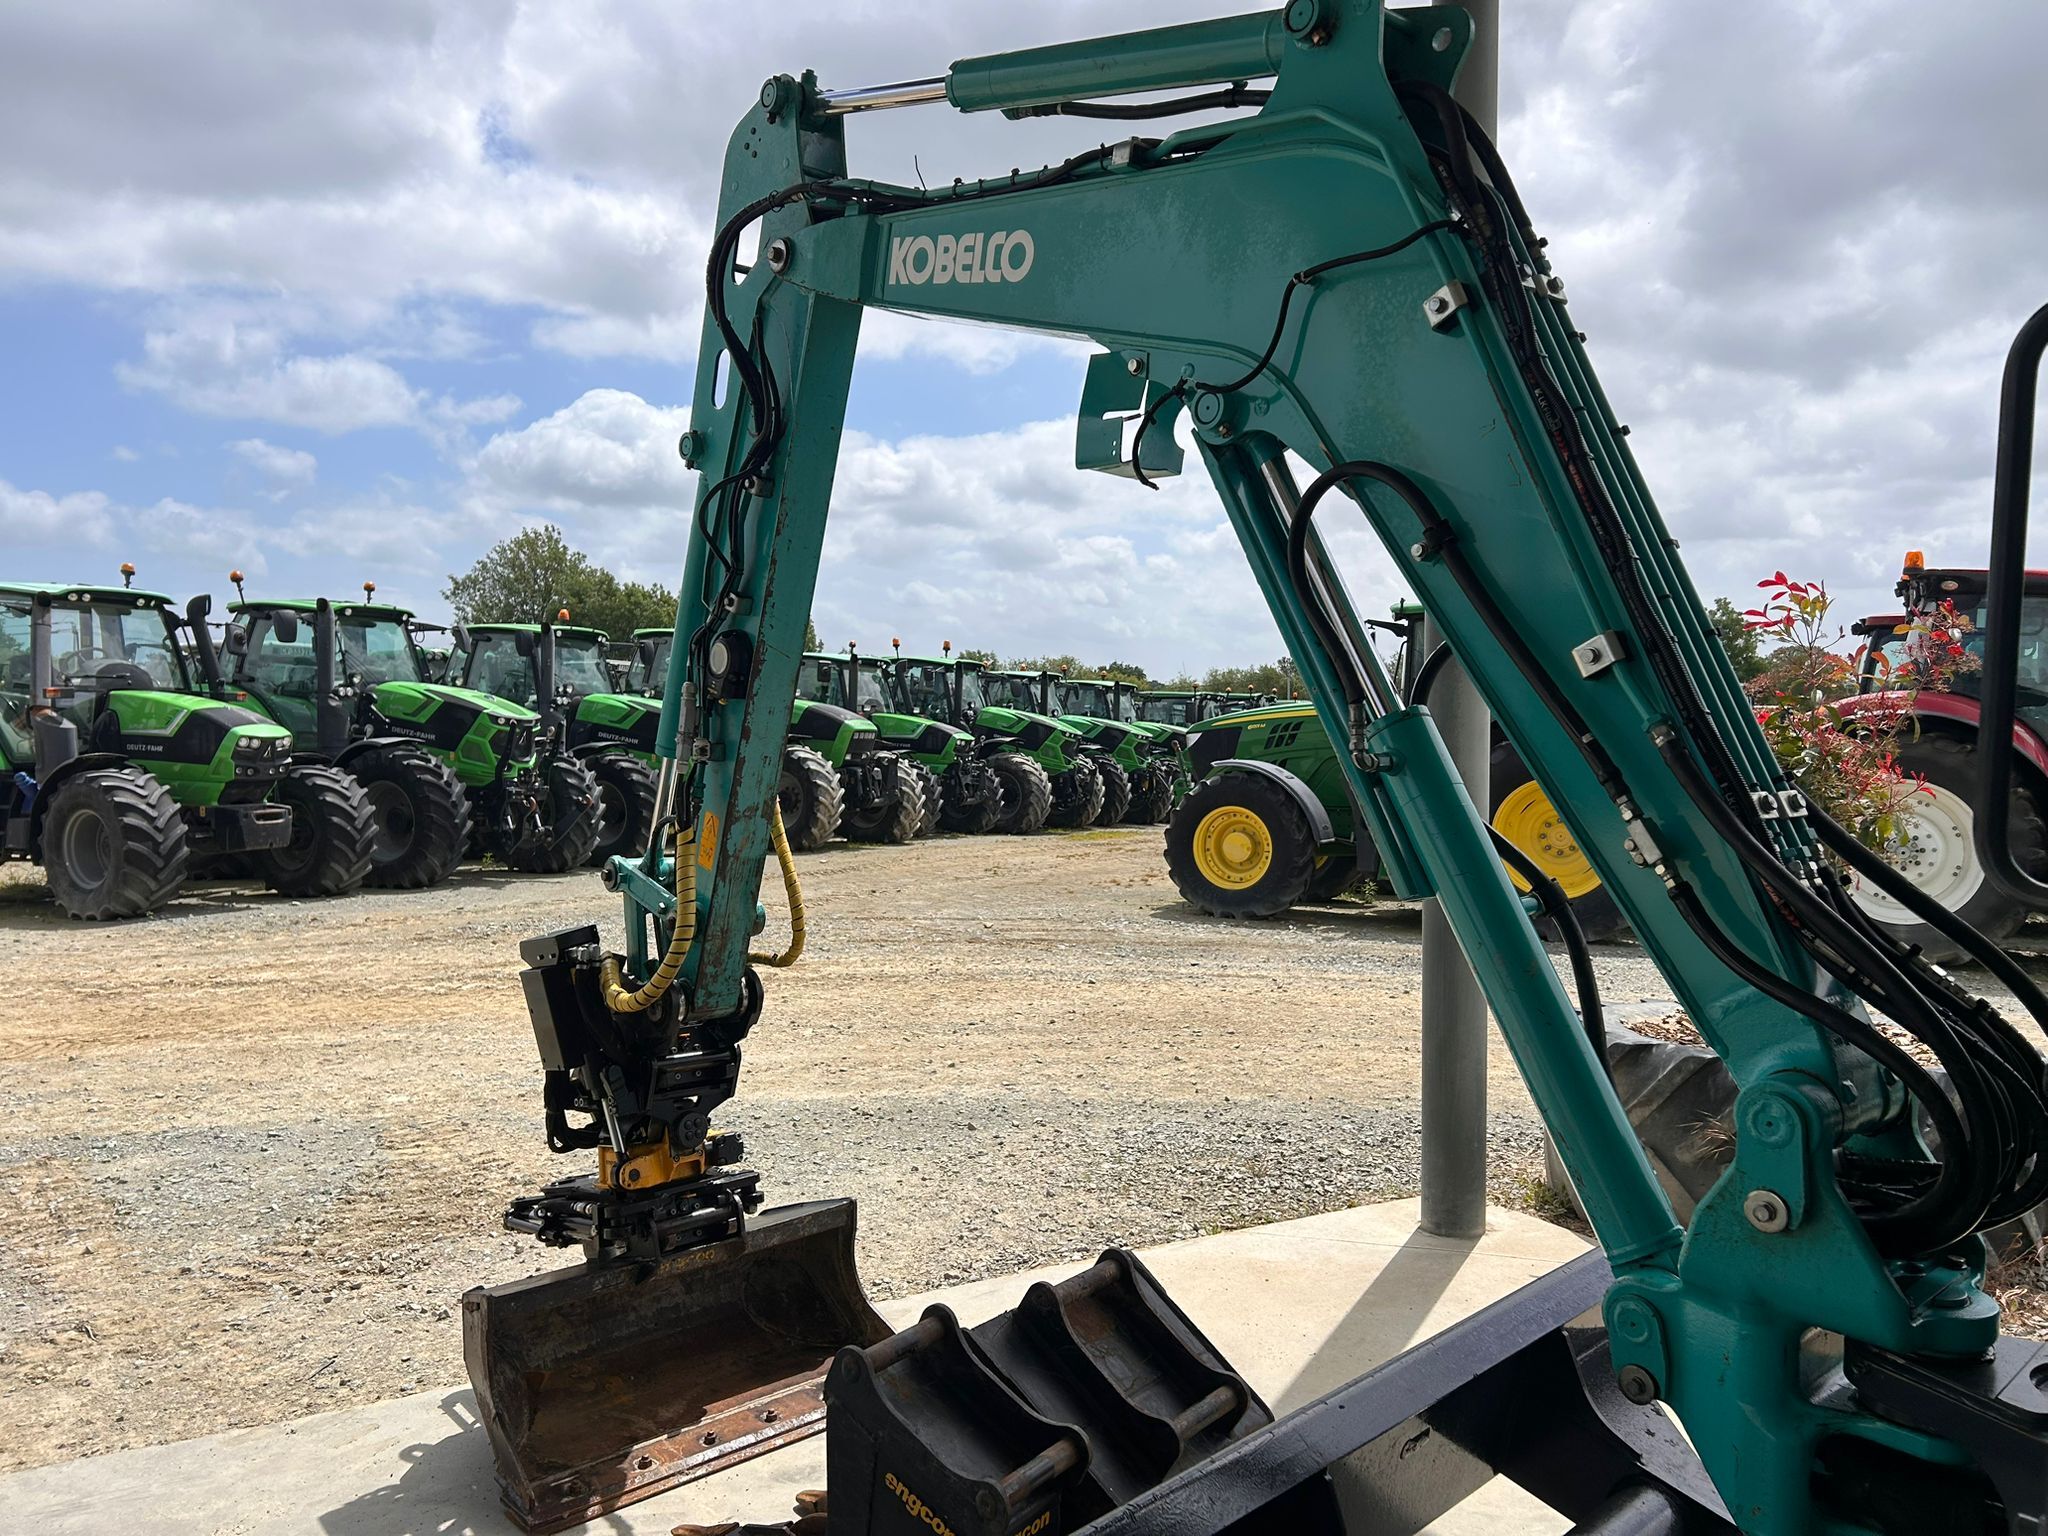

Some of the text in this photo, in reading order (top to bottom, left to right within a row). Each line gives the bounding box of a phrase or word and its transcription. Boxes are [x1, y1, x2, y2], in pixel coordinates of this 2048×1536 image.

[888, 229, 1035, 285] KOBELCO
[391, 726, 436, 741] DEUTZ-FAHR
[598, 731, 639, 744] DEUTZ-FAHR
[1014, 1510, 1051, 1536] con
